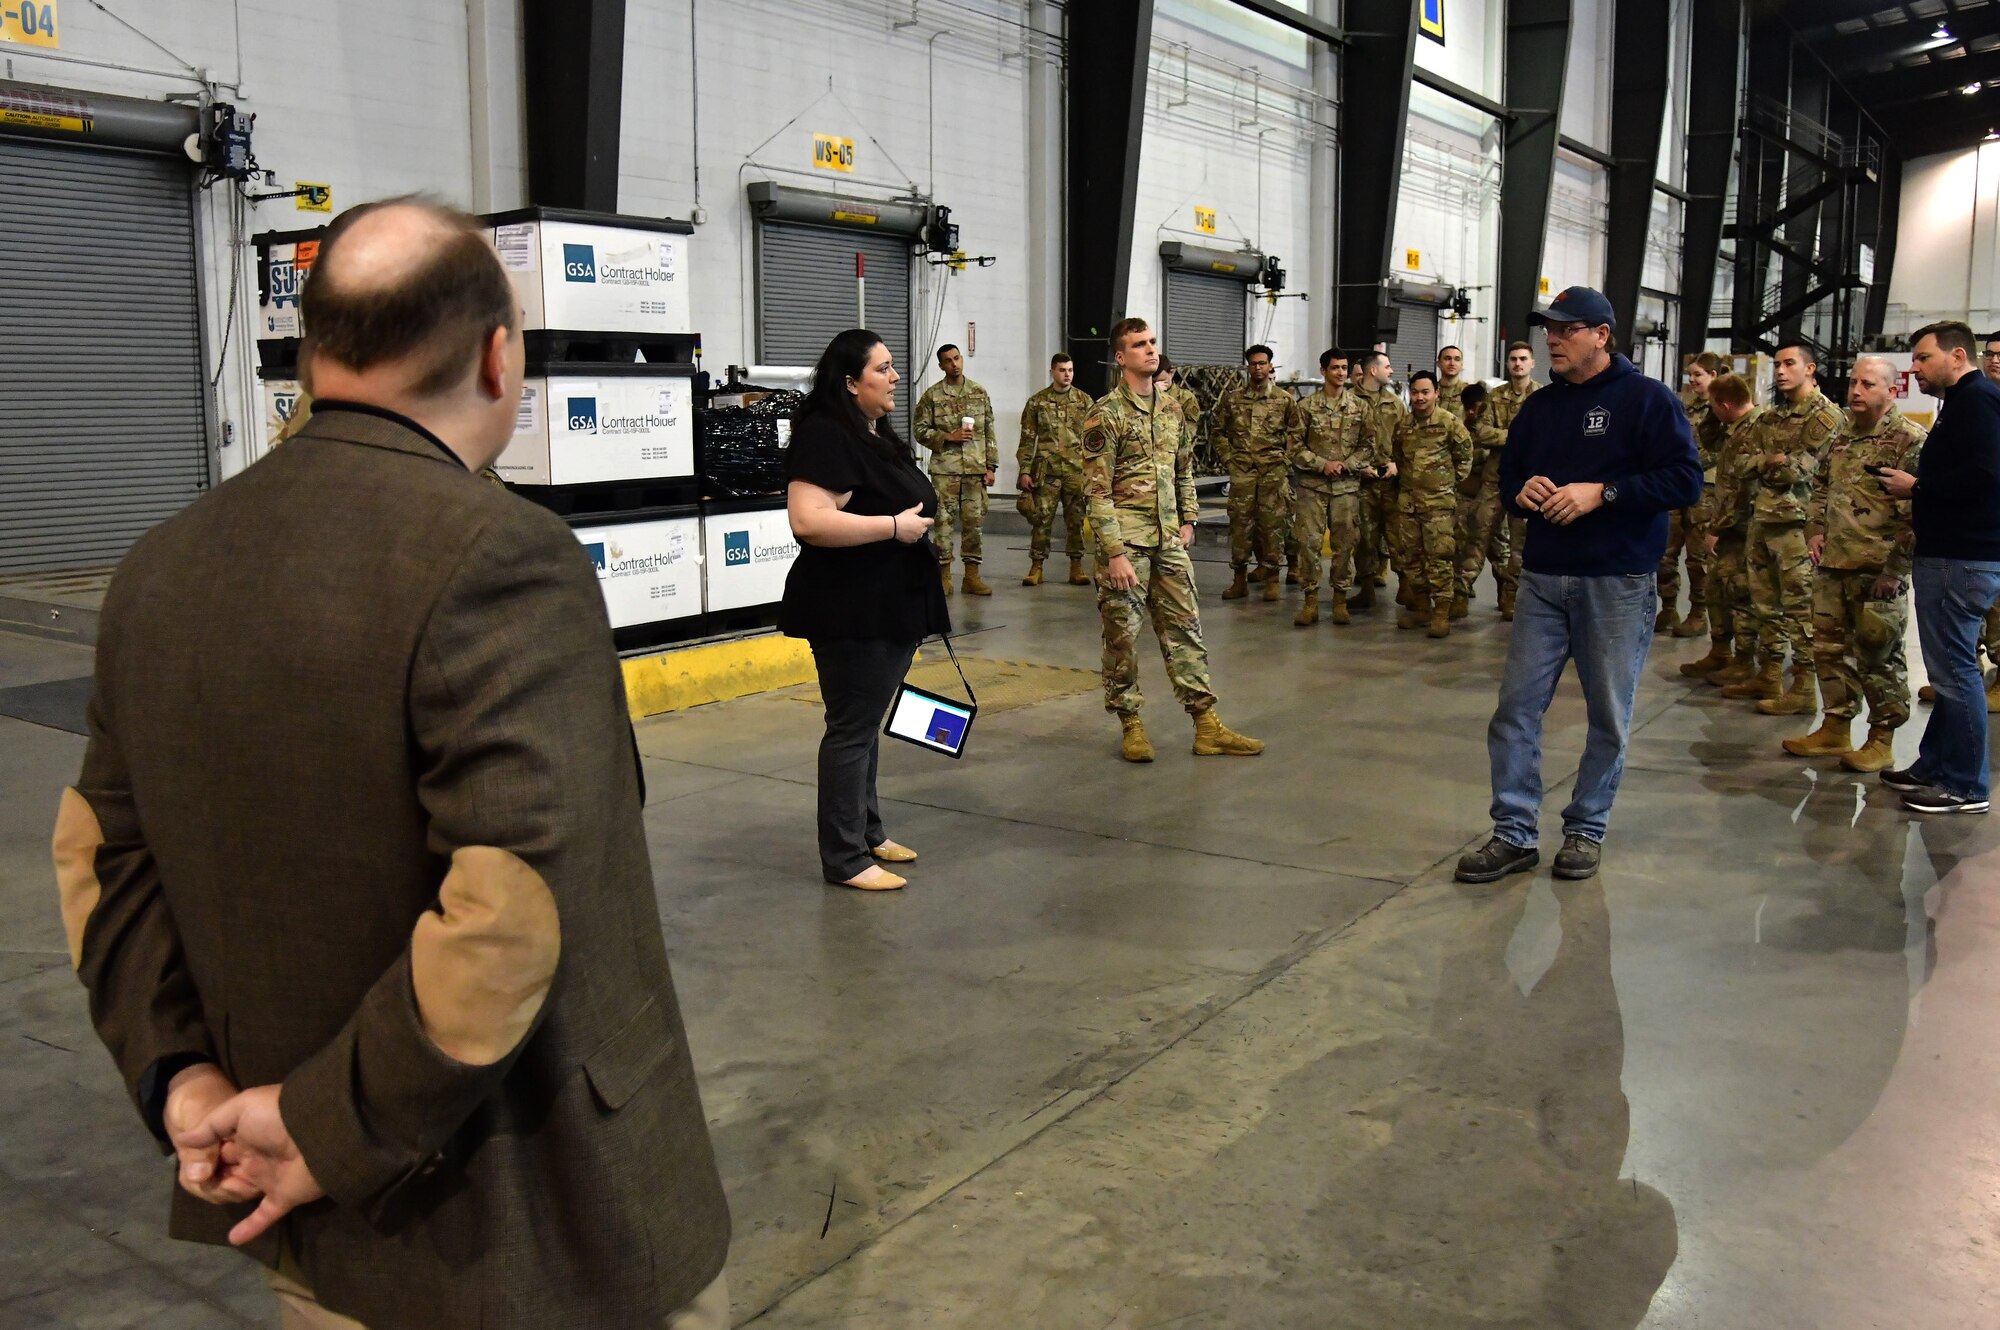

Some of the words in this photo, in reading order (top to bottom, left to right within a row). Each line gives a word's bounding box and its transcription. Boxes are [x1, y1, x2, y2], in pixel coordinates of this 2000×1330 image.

[0, 0, 53, 37] -04
[815, 140, 853, 166] WS-05
[567, 262, 594, 277] GSA
[600, 264, 643, 280] Contract
[570, 416, 595, 430] GSA
[601, 415, 644, 428] Contract
[1588, 416, 1604, 428] 12
[726, 547, 749, 561] GSA
[754, 543, 790, 558] Contract
[610, 555, 653, 572] Contract
